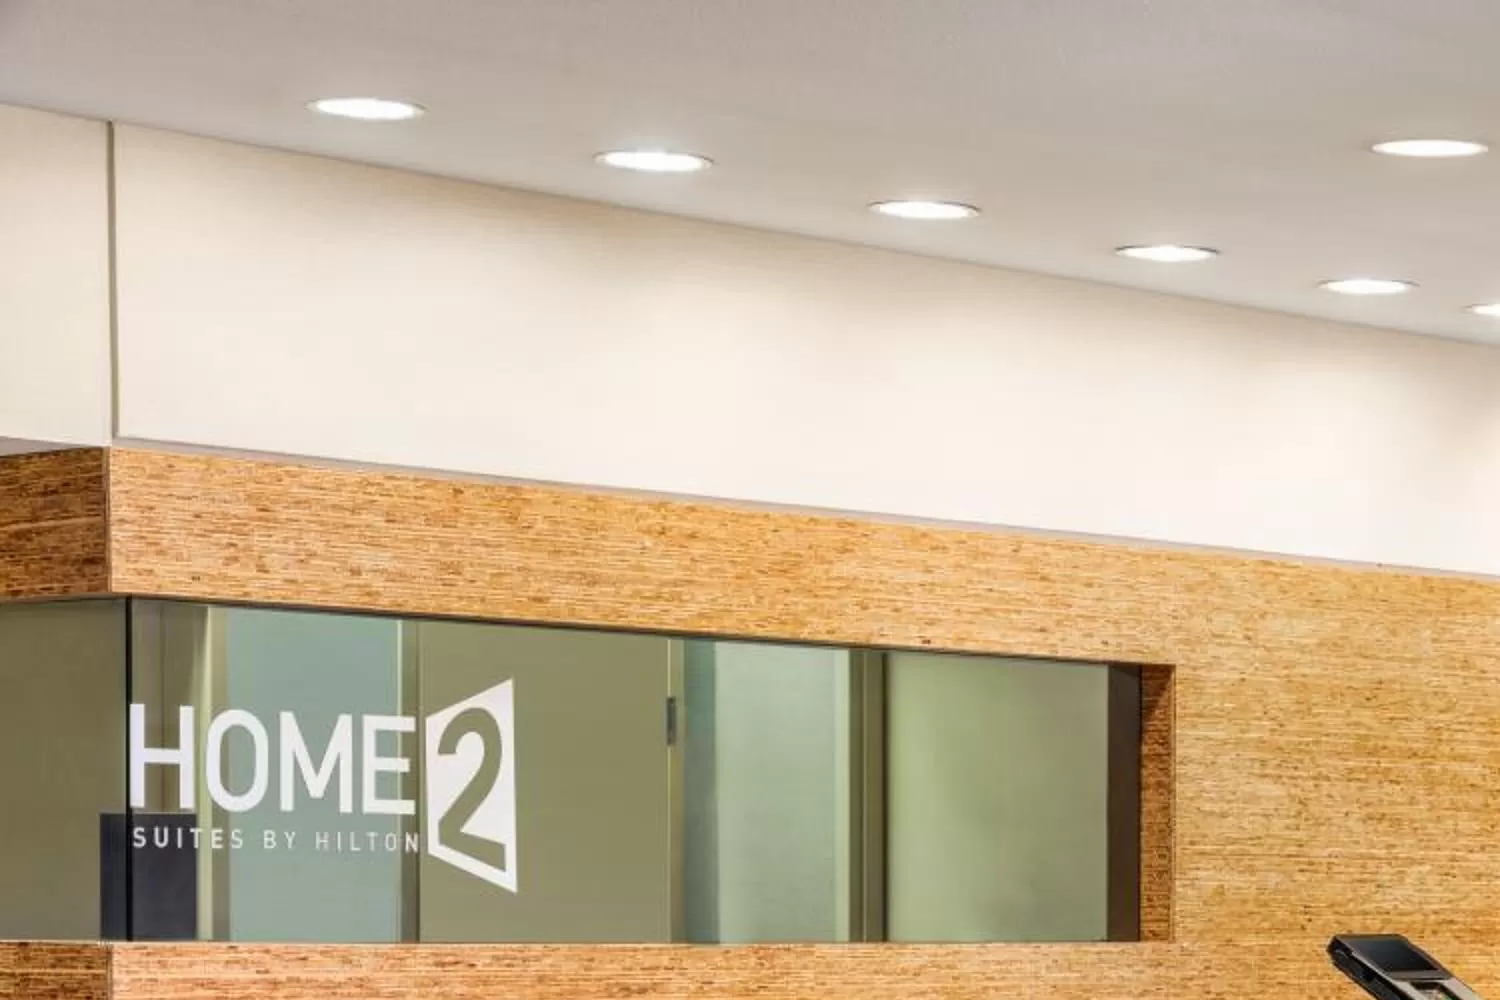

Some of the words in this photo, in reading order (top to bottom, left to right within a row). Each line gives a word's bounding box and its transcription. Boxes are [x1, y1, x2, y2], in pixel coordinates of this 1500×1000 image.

[132, 827, 244, 849] SUITES
[263, 831, 297, 850] BY
[315, 832, 420, 853] HILTON
